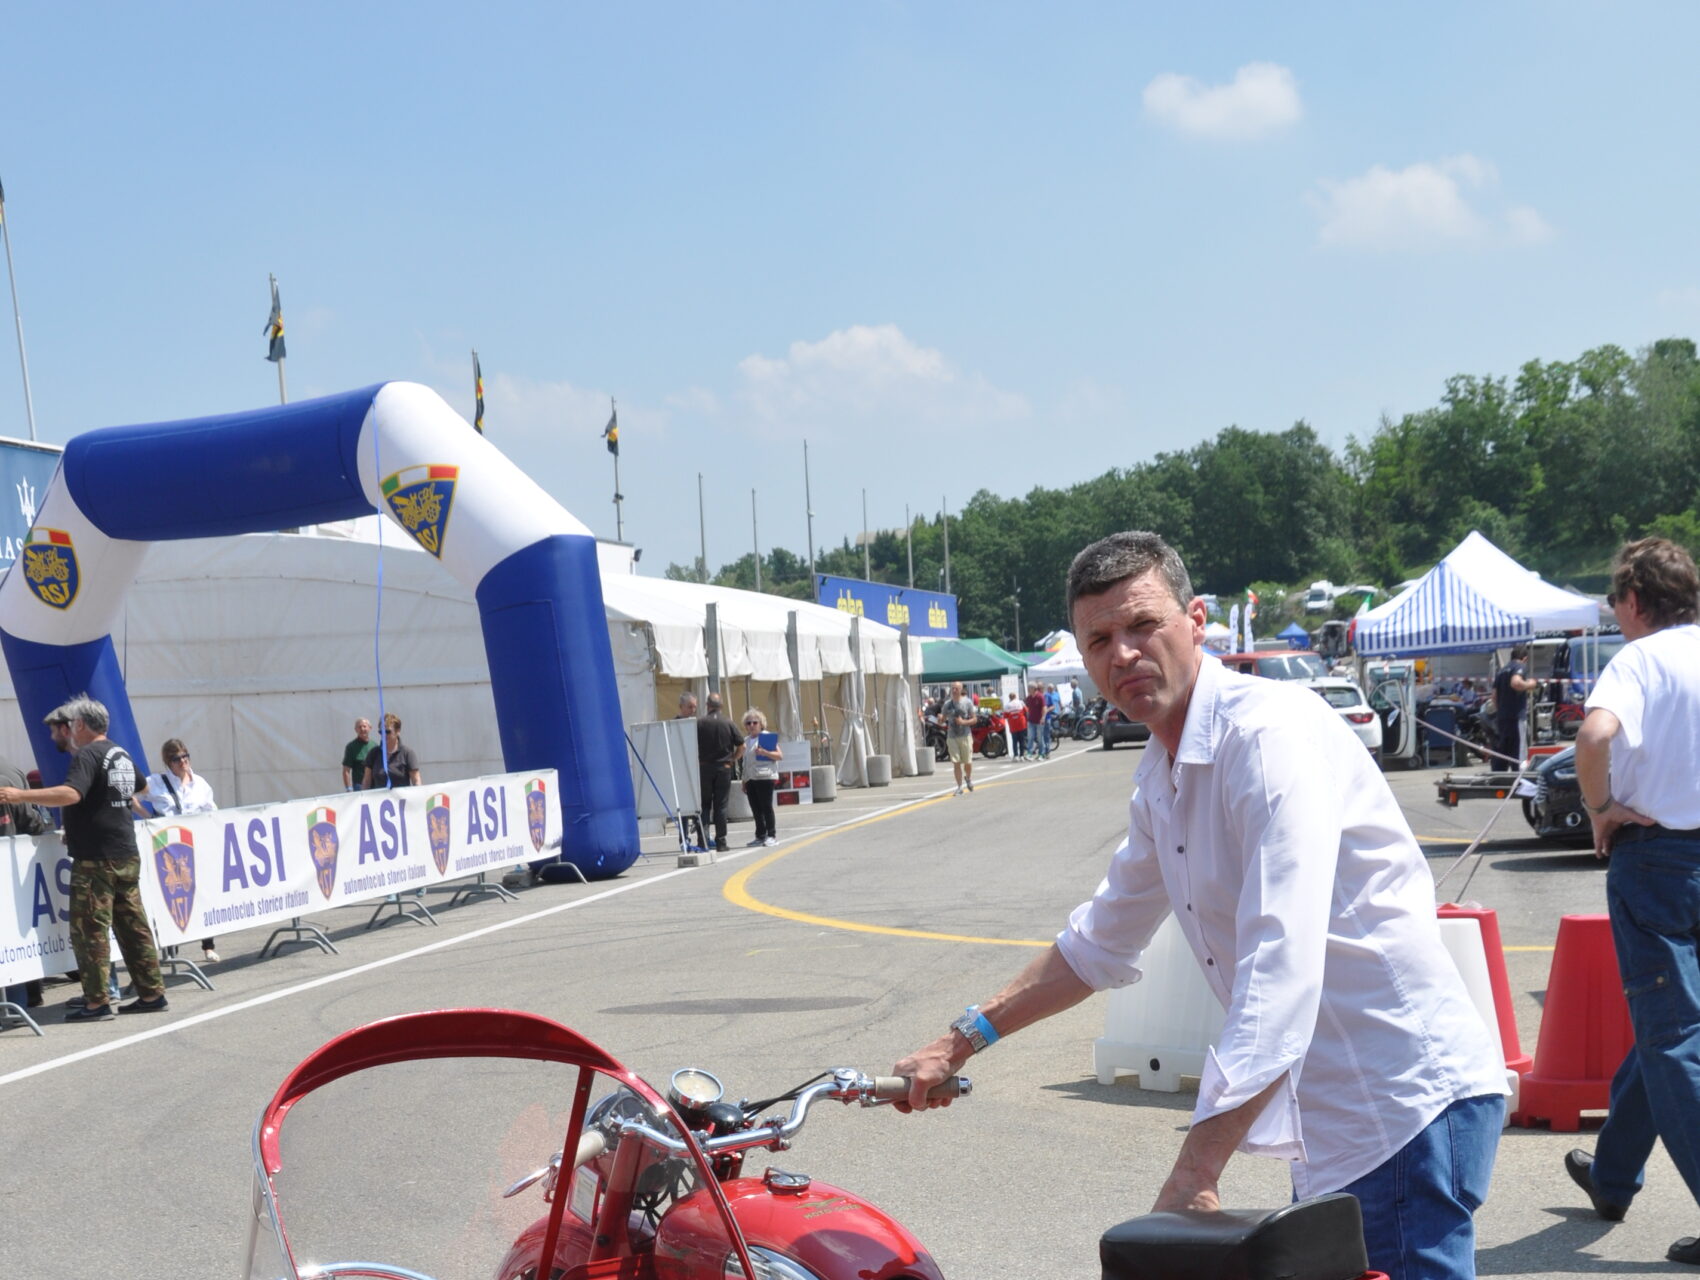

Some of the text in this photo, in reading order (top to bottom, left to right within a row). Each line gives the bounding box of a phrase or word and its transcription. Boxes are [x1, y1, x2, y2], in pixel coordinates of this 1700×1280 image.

[37, 582, 70, 605] ASI
[359, 799, 408, 865] ASI
[467, 786, 507, 845] ASI
[222, 817, 286, 893] ASI
[32, 858, 74, 928] AS
[203, 890, 309, 928] automotoclub storico italiano
[0, 934, 65, 965] utomotoclub
